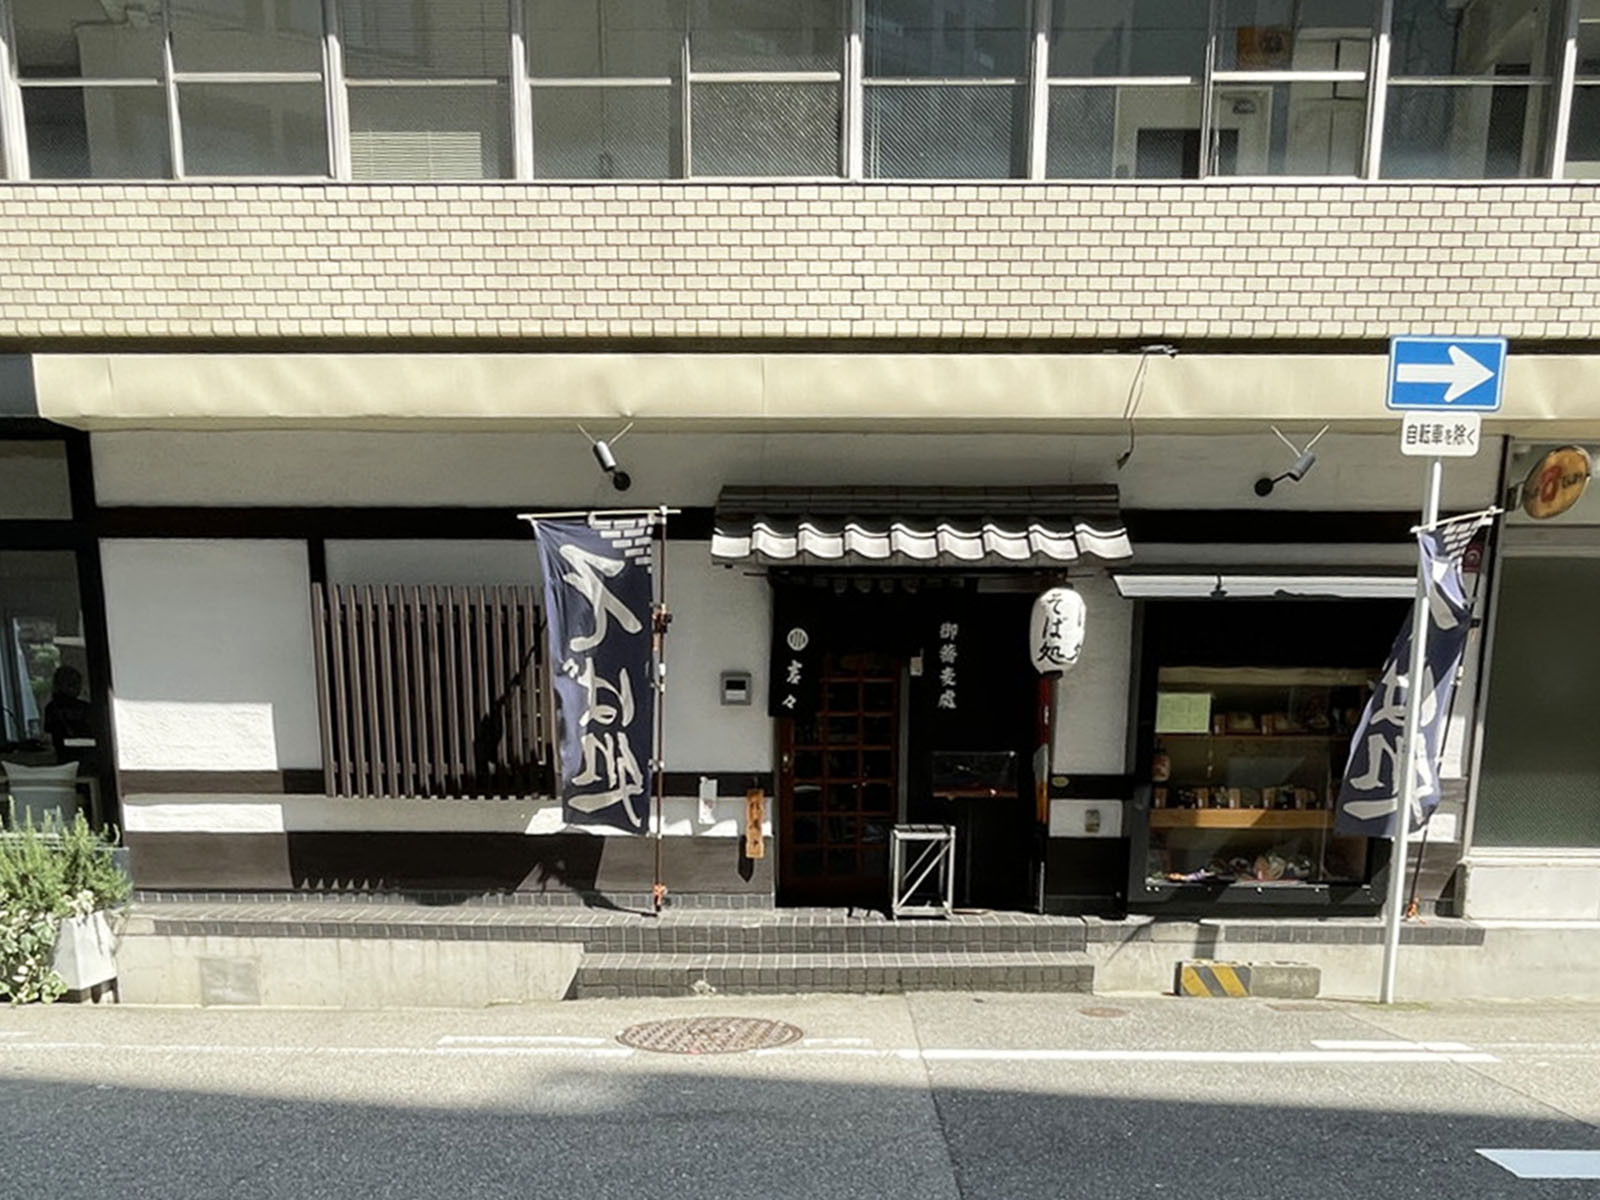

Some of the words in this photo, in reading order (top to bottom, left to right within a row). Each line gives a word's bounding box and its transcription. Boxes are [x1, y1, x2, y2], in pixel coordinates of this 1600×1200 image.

[1406, 424, 1476, 445] 自転車を除く
[1037, 593, 1066, 665] そば処
